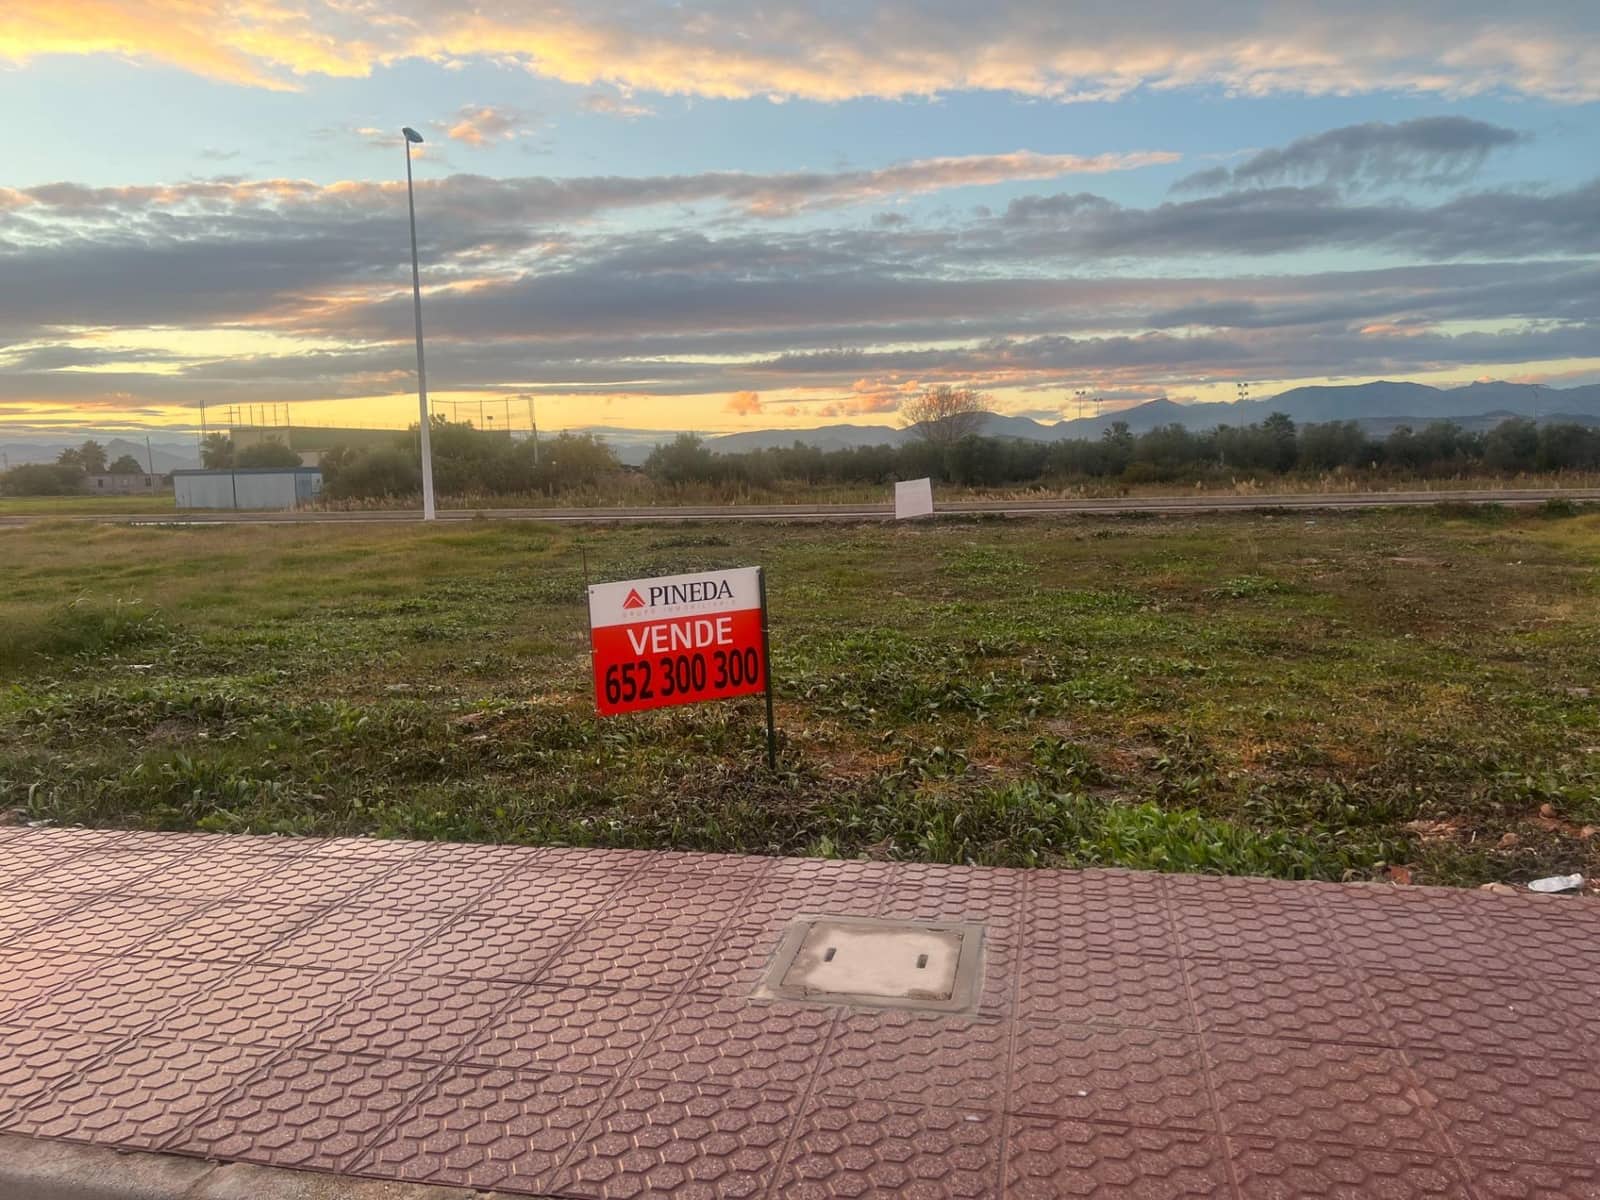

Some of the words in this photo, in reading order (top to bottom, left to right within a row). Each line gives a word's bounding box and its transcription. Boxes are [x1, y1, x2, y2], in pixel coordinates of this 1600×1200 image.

[648, 579, 734, 607] PINEDA
[627, 617, 733, 656] VENDE
[605, 660, 653, 704] 652
[660, 653, 706, 697] 300
[713, 647, 759, 689] 300
